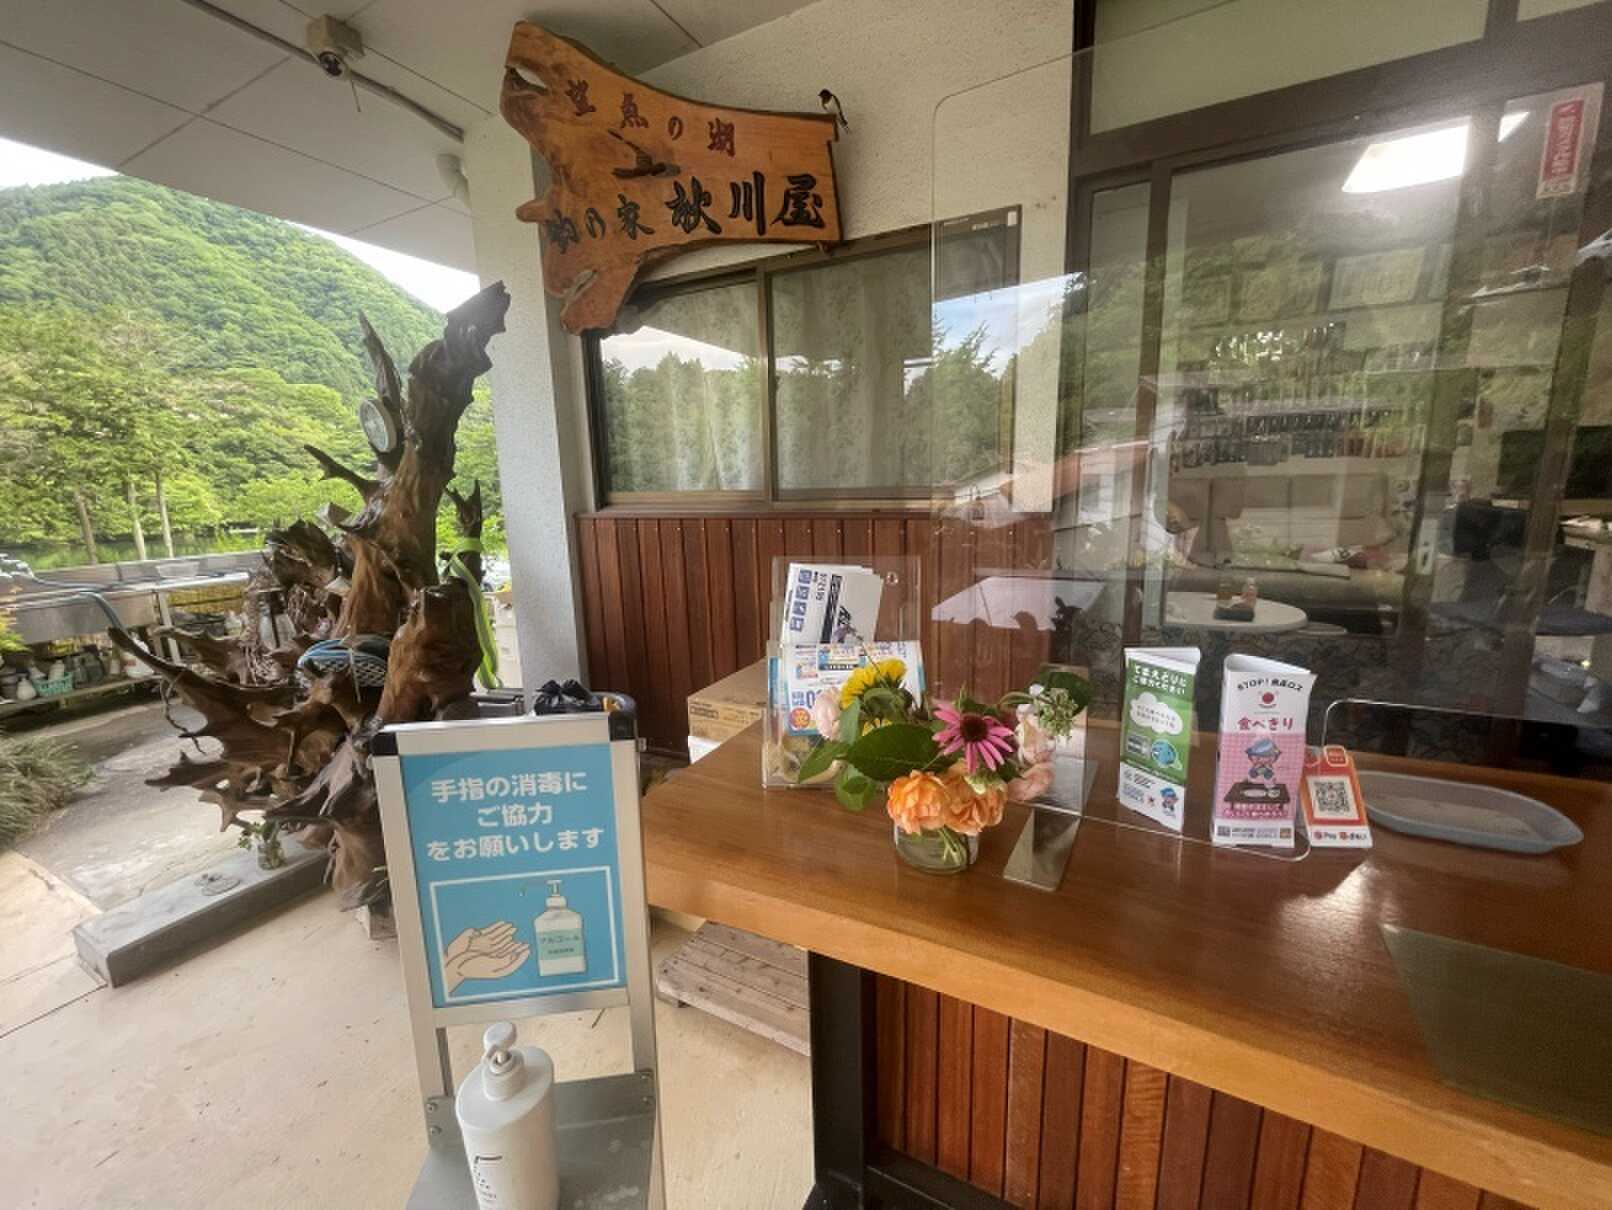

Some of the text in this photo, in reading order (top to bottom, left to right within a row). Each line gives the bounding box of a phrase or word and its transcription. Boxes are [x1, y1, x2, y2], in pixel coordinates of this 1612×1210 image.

[664, 170, 826, 237] 秋川屋
[1236, 716, 1294, 731] 食べきり
[431, 771, 587, 804] 手指の消毒に
[477, 801, 554, 828] ご協力
[426, 827, 604, 862] をお願いします
